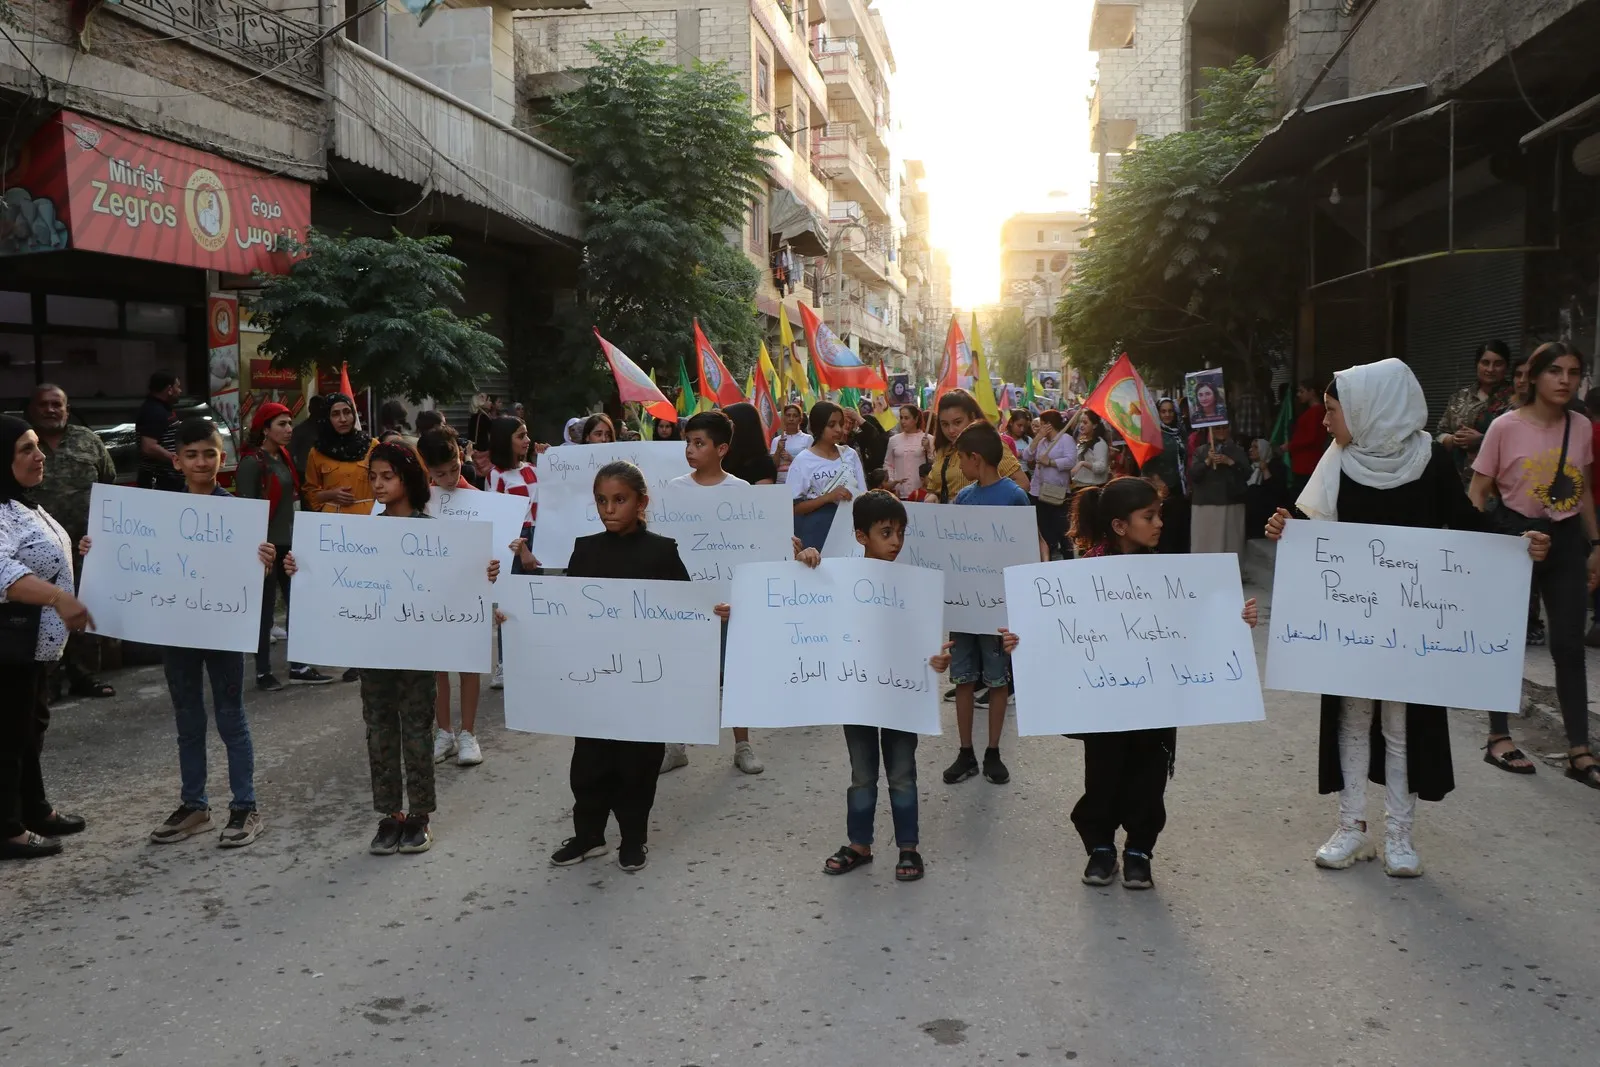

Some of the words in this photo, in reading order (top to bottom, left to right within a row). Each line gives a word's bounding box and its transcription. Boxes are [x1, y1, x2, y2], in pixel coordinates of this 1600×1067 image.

[91, 180, 177, 227] Zegros
[251, 194, 282, 219] فروج
[548, 453, 580, 480] Rojava
[102, 500, 156, 537] Erdoxan
[179, 507, 235, 543] Qatilê
[320, 524, 378, 555] Erdoxan
[401, 532, 450, 558] Qatilê
[690, 532, 745, 552] Zarokan
[1315, 537, 1345, 563] Em
[529, 582, 568, 617] Em
[767, 577, 834, 608] Erdoxan
[974, 590, 1006, 609] عونا
[1034, 577, 1076, 607] Bila
[1091, 574, 1153, 602] Hevalên
[1164, 575, 1197, 601] Me
[393, 602, 426, 623] قاتل
[430, 595, 486, 623] أردوغان
[784, 622, 829, 646] Jinan
[1058, 618, 1109, 662] Neyên
[1379, 628, 1398, 649] لا
[1478, 632, 1511, 655] نحن
[631, 653, 664, 684] لا
[837, 659, 868, 683] قاتل
[1171, 663, 1214, 686] تقتلوا
[1226, 650, 1243, 681] لا
